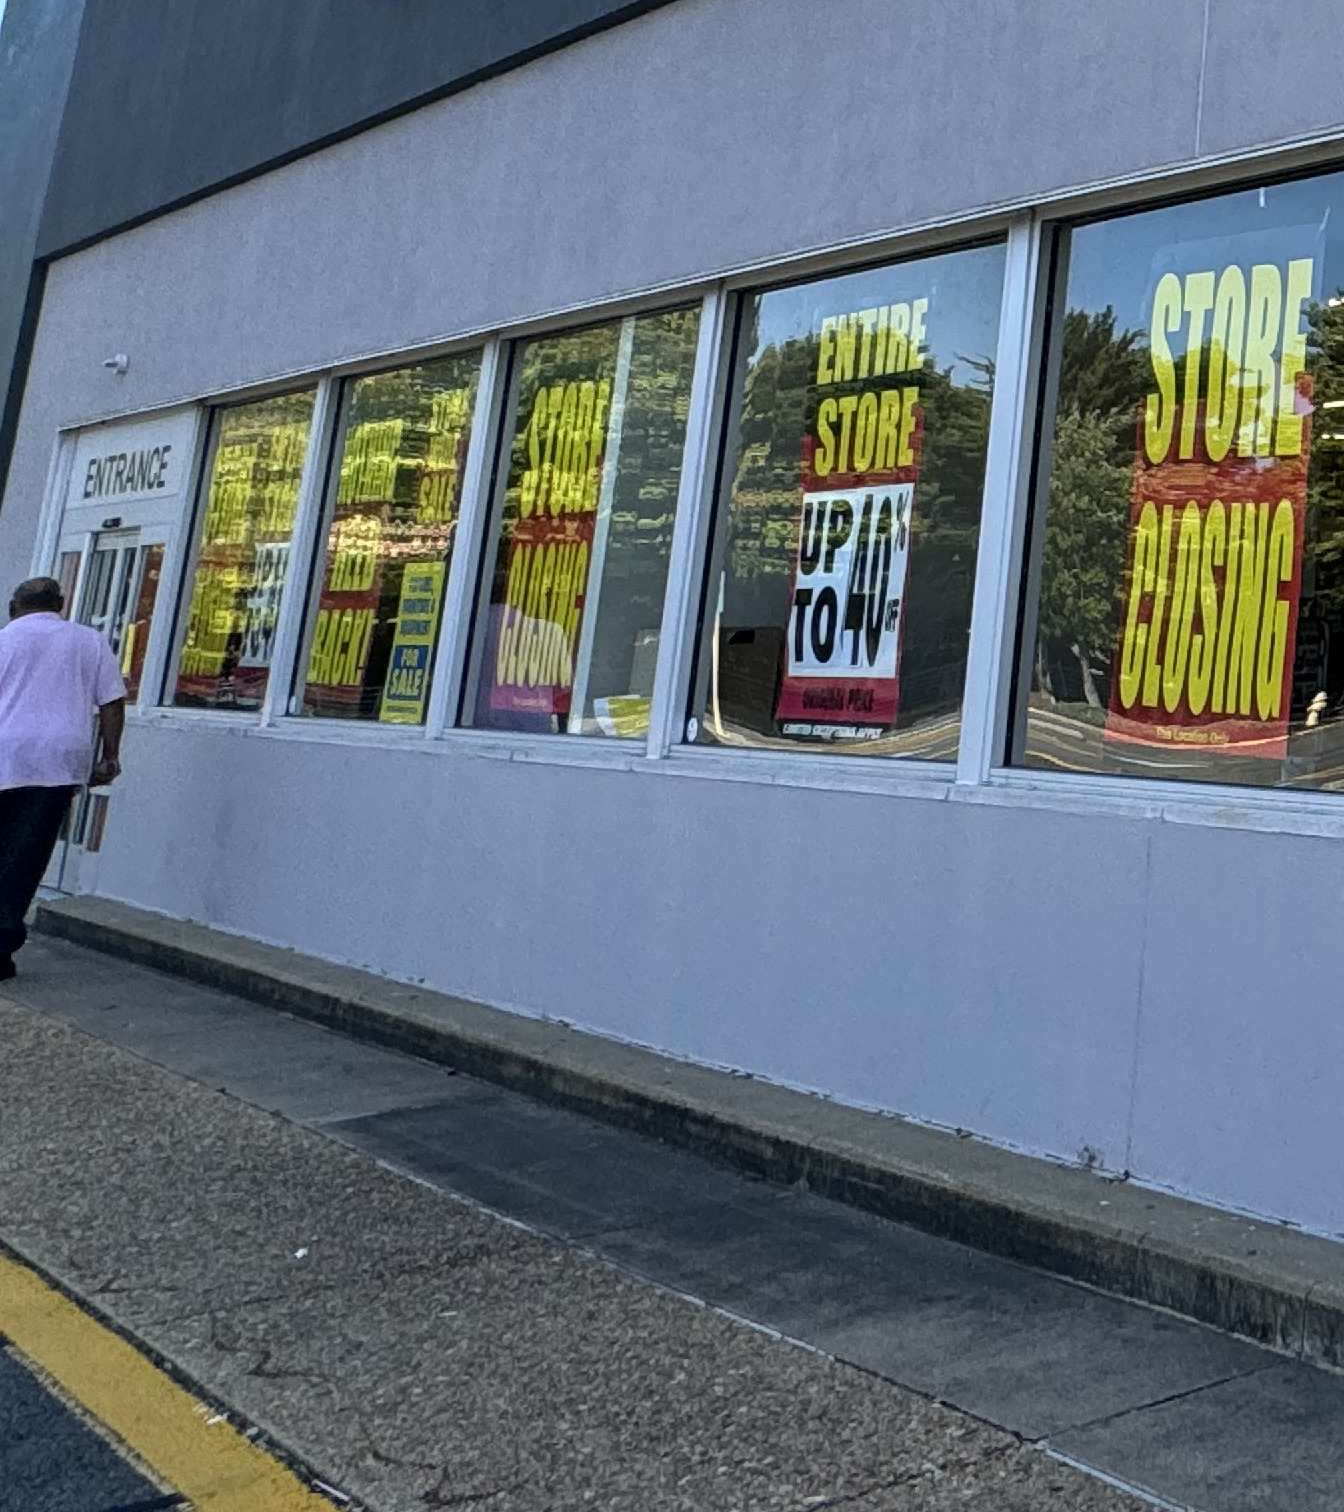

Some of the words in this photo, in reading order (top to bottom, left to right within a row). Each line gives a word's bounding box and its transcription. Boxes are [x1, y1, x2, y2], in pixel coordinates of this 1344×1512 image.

[815, 297, 928, 385] ENTIRE
[1143, 258, 1314, 465] STORE
[84, 445, 172, 499] ENTRANCE
[814, 386, 919, 478] STORE
[800, 499, 854, 576] UP
[794, 586, 838, 664] TO
[1118, 499, 1294, 721] CLOSING
[390, 667, 422, 696] SALE
